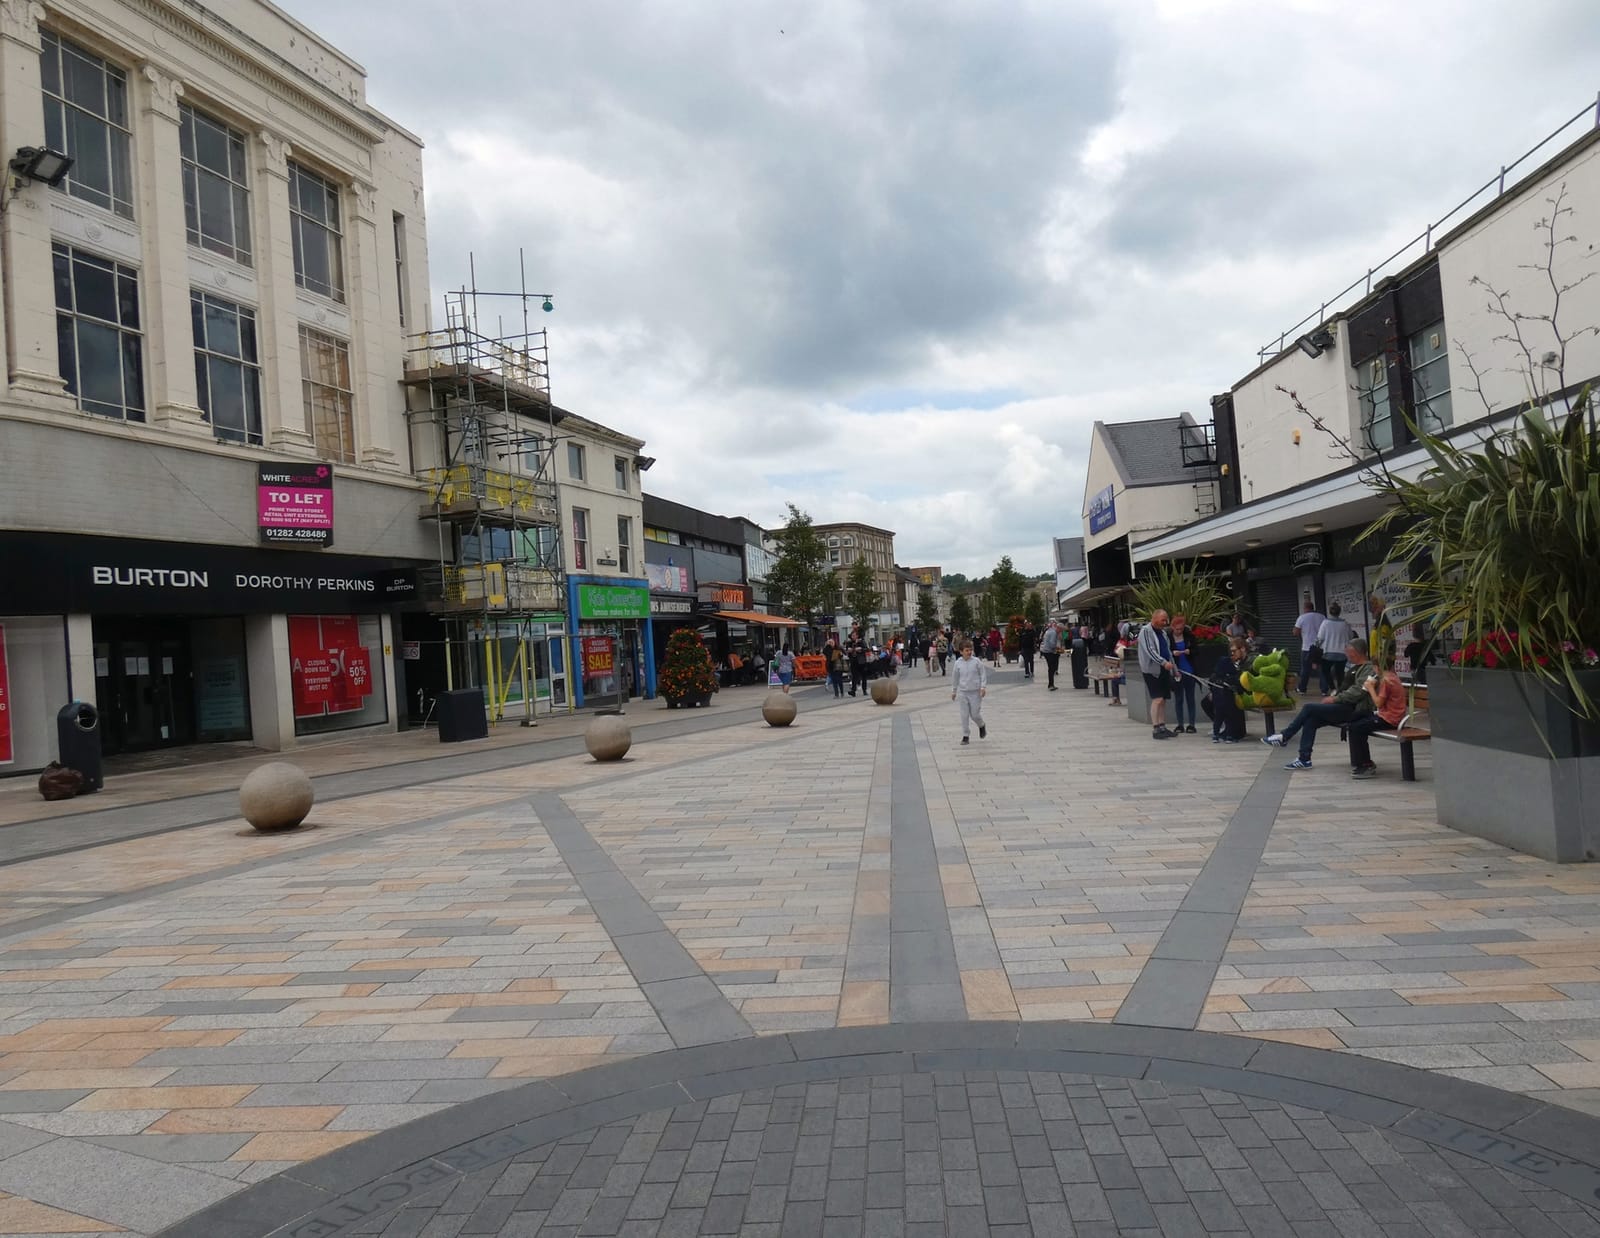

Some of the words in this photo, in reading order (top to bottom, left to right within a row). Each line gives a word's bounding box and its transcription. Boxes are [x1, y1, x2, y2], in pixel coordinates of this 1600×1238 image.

[269, 493, 290, 503] TO
[295, 494, 323, 504] LET
[267, 529, 293, 537] 01282
[296, 530, 326, 538] 428486
[93, 566, 208, 587] BURTON
[236, 575, 313, 589] DOROTHY
[318, 578, 374, 591] PERKINS
[589, 654, 610, 669] SALE
[350, 666, 366, 677] 50%
[354, 678, 364, 686] OFF
[1407, 1116, 1552, 1174] SITE
